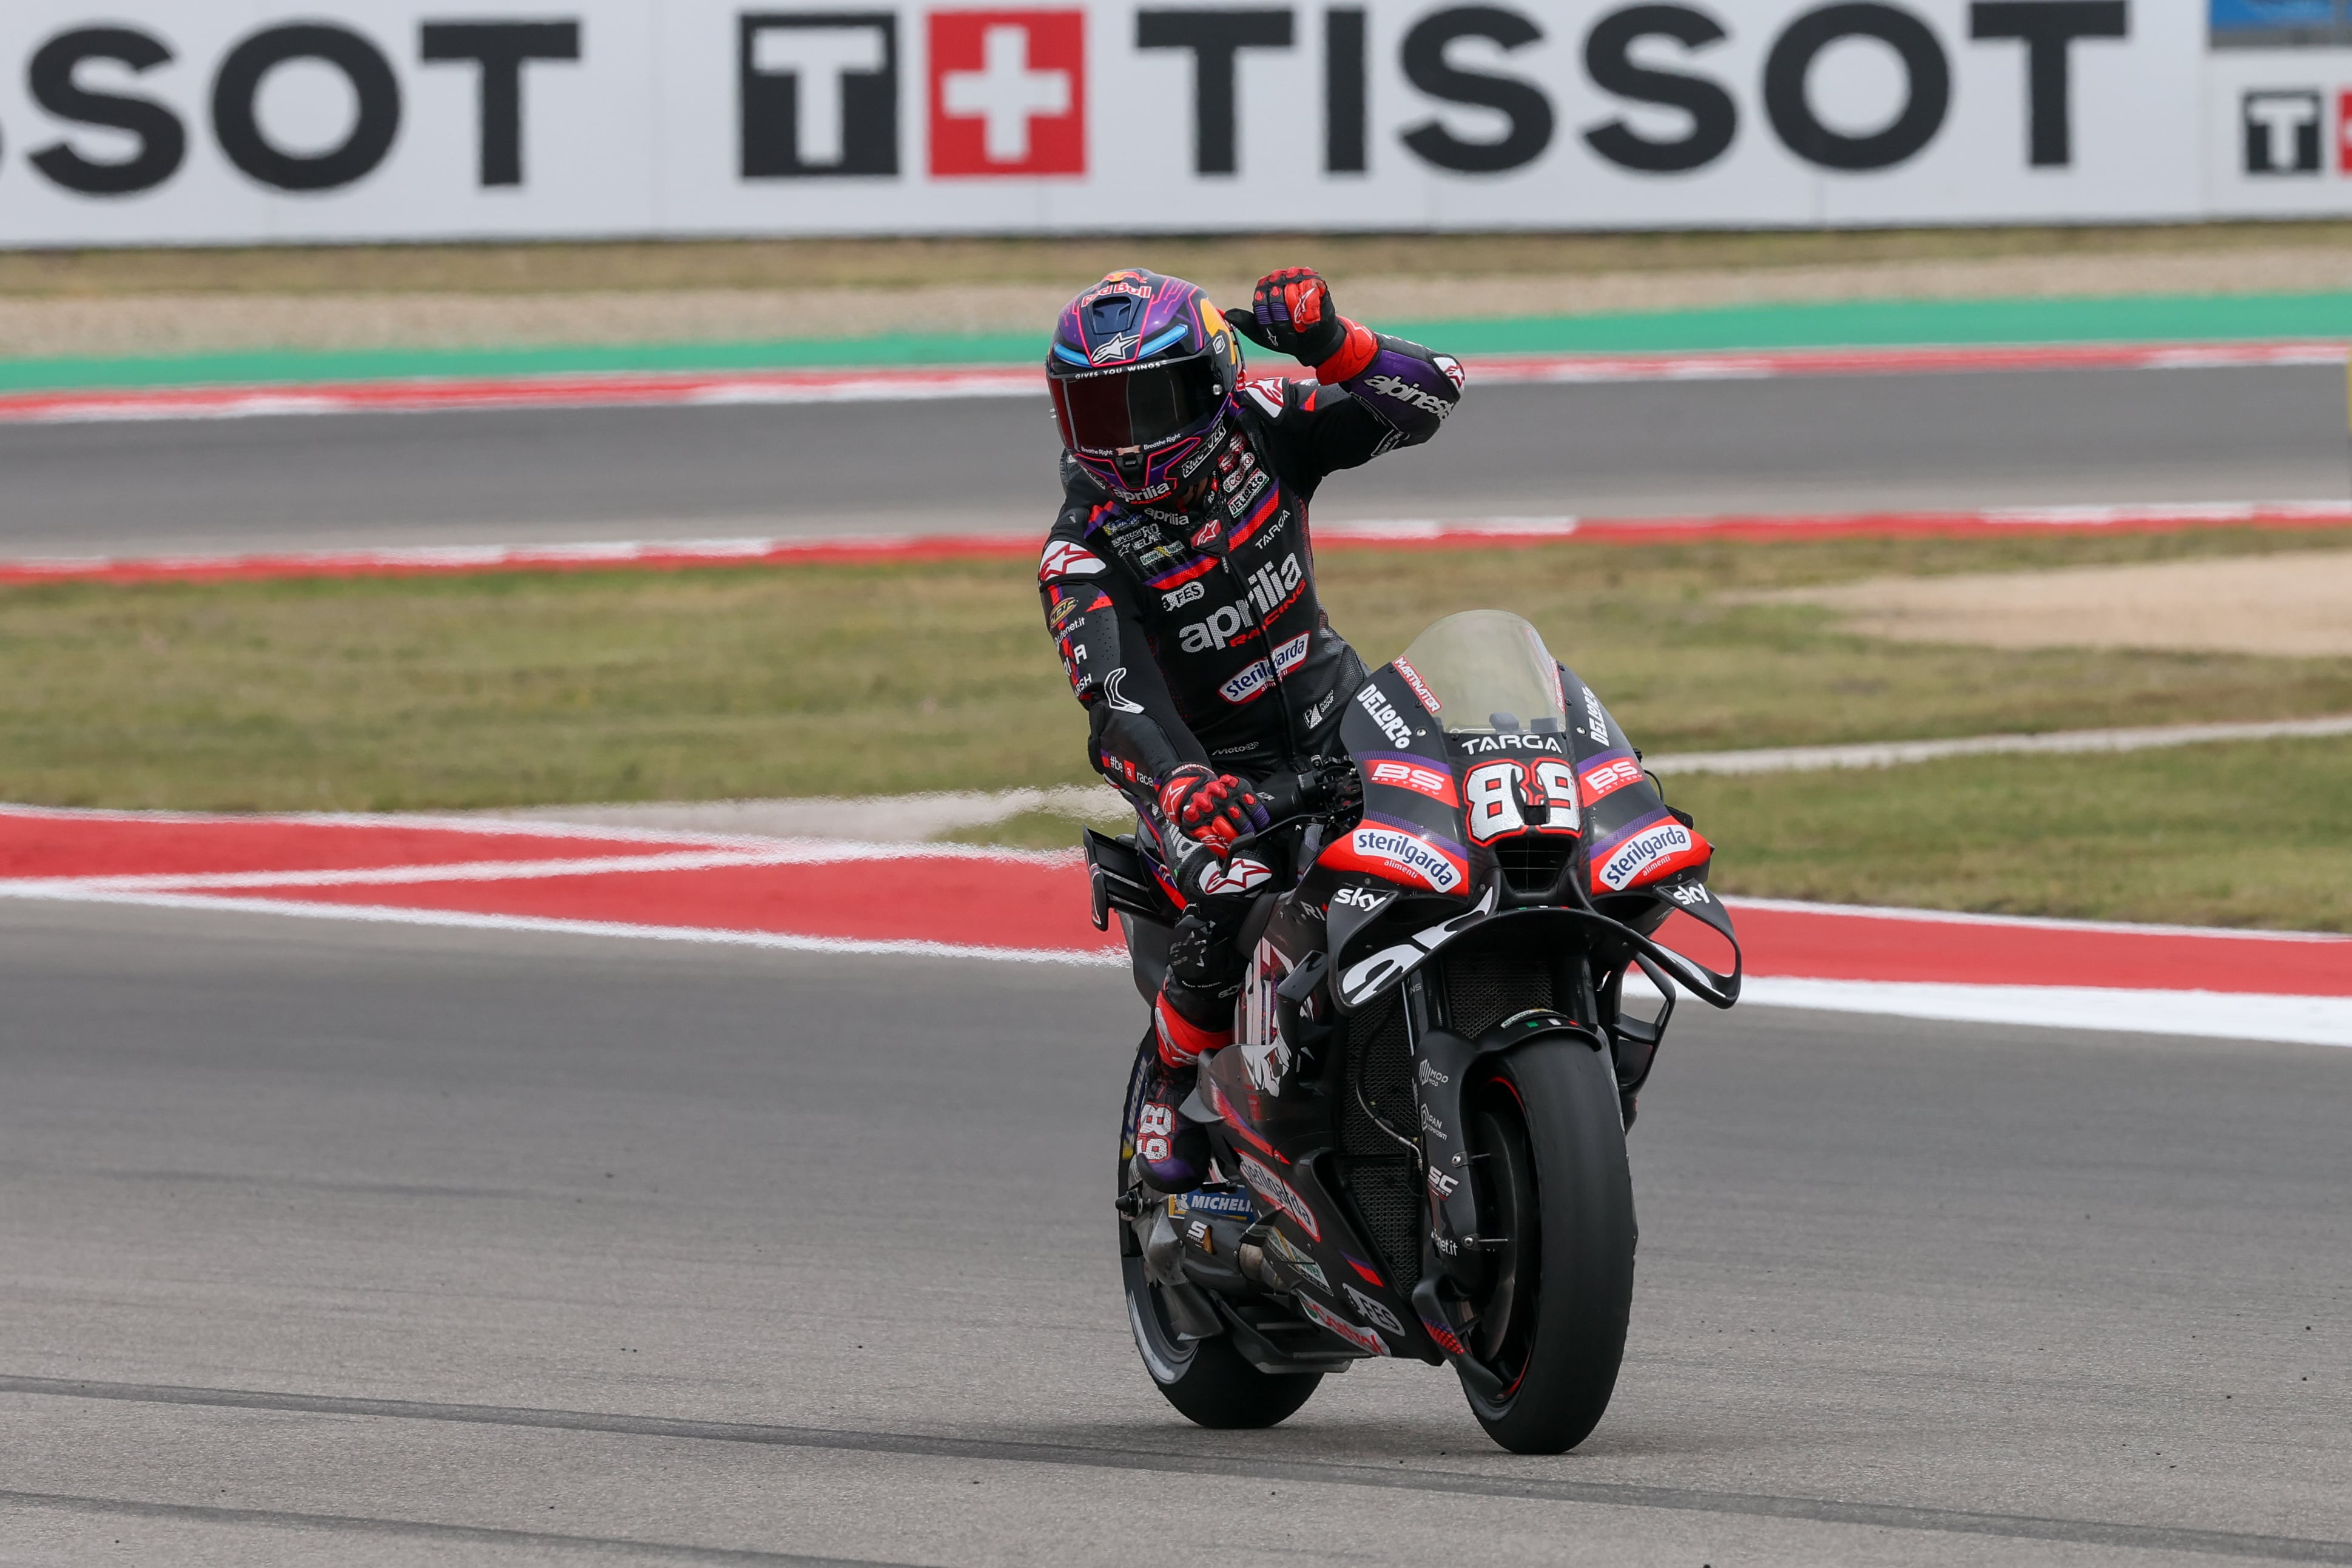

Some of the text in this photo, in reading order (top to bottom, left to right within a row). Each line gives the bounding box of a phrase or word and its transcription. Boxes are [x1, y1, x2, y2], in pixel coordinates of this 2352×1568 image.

[1136, 1, 2128, 175] TISSOT
[0, 20, 581, 197] SOT
[1081, 282, 1152, 308] Red Bull
[1075, 371, 1099, 380] GIVES
[1127, 362, 1161, 372] WINGS
[1080, 446, 1099, 454] Breathe
[1143, 432, 1182, 450] Breathe Right
[1113, 482, 1171, 503] aprilia
[1144, 507, 1190, 526] aprilia
[1255, 509, 1291, 550] TARGA
[1179, 553, 1303, 653] aprilia
[1075, 673, 1093, 698] ARSH
[1394, 656, 1441, 713] MARTINATOR
[1461, 735, 1563, 755] TARGA
[1127, 767, 1133, 778] a
[1136, 771, 1153, 787] race
[1373, 763, 1445, 790] BS
[1585, 761, 1639, 791] BS
[1463, 758, 1582, 846] 89
[1358, 832, 1453, 886] sterilgarda
[1606, 826, 1686, 885] sterilgarda
[1642, 854, 1671, 877] alimenti
[1384, 858, 1418, 880] alimenti
[1334, 887, 1387, 912] sky
[1673, 883, 1710, 906] sky
[1430, 1069, 1449, 1084] MOD
[1428, 1114, 1443, 1129] PAN
[1429, 1165, 1459, 1193] SC
[1191, 1195, 1253, 1213] MICHELI
